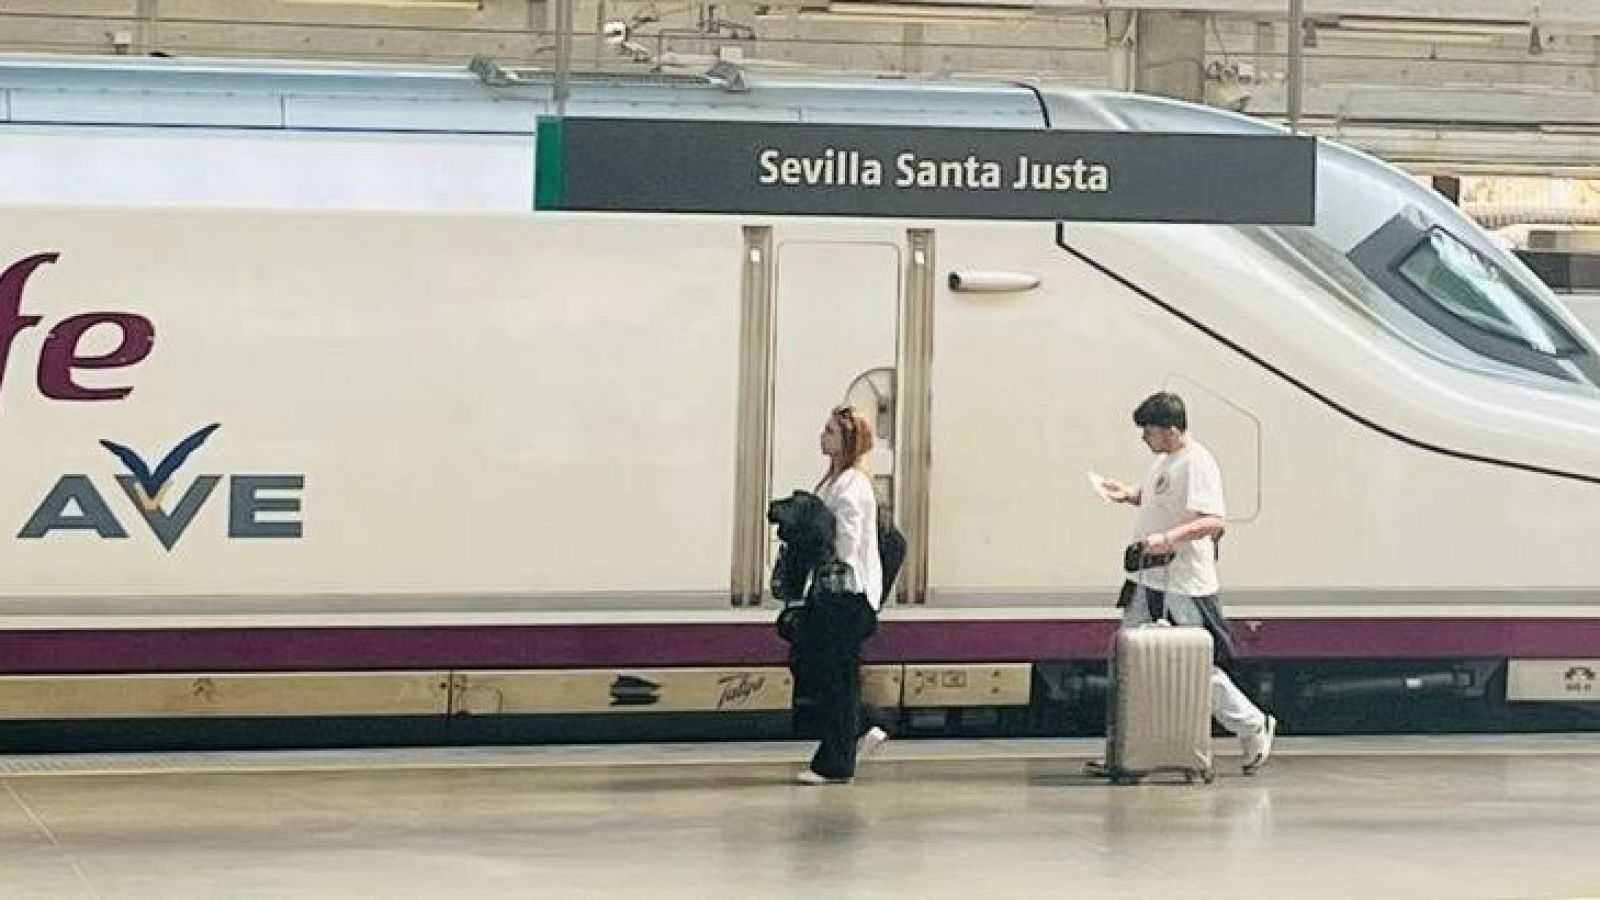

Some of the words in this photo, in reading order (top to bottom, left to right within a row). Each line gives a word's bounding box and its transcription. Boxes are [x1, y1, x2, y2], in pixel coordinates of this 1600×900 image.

[759, 149, 882, 185] Sevilla
[896, 153, 1001, 188] Santa
[1013, 155, 1109, 192] Justa
[16, 473, 305, 551] AVE
